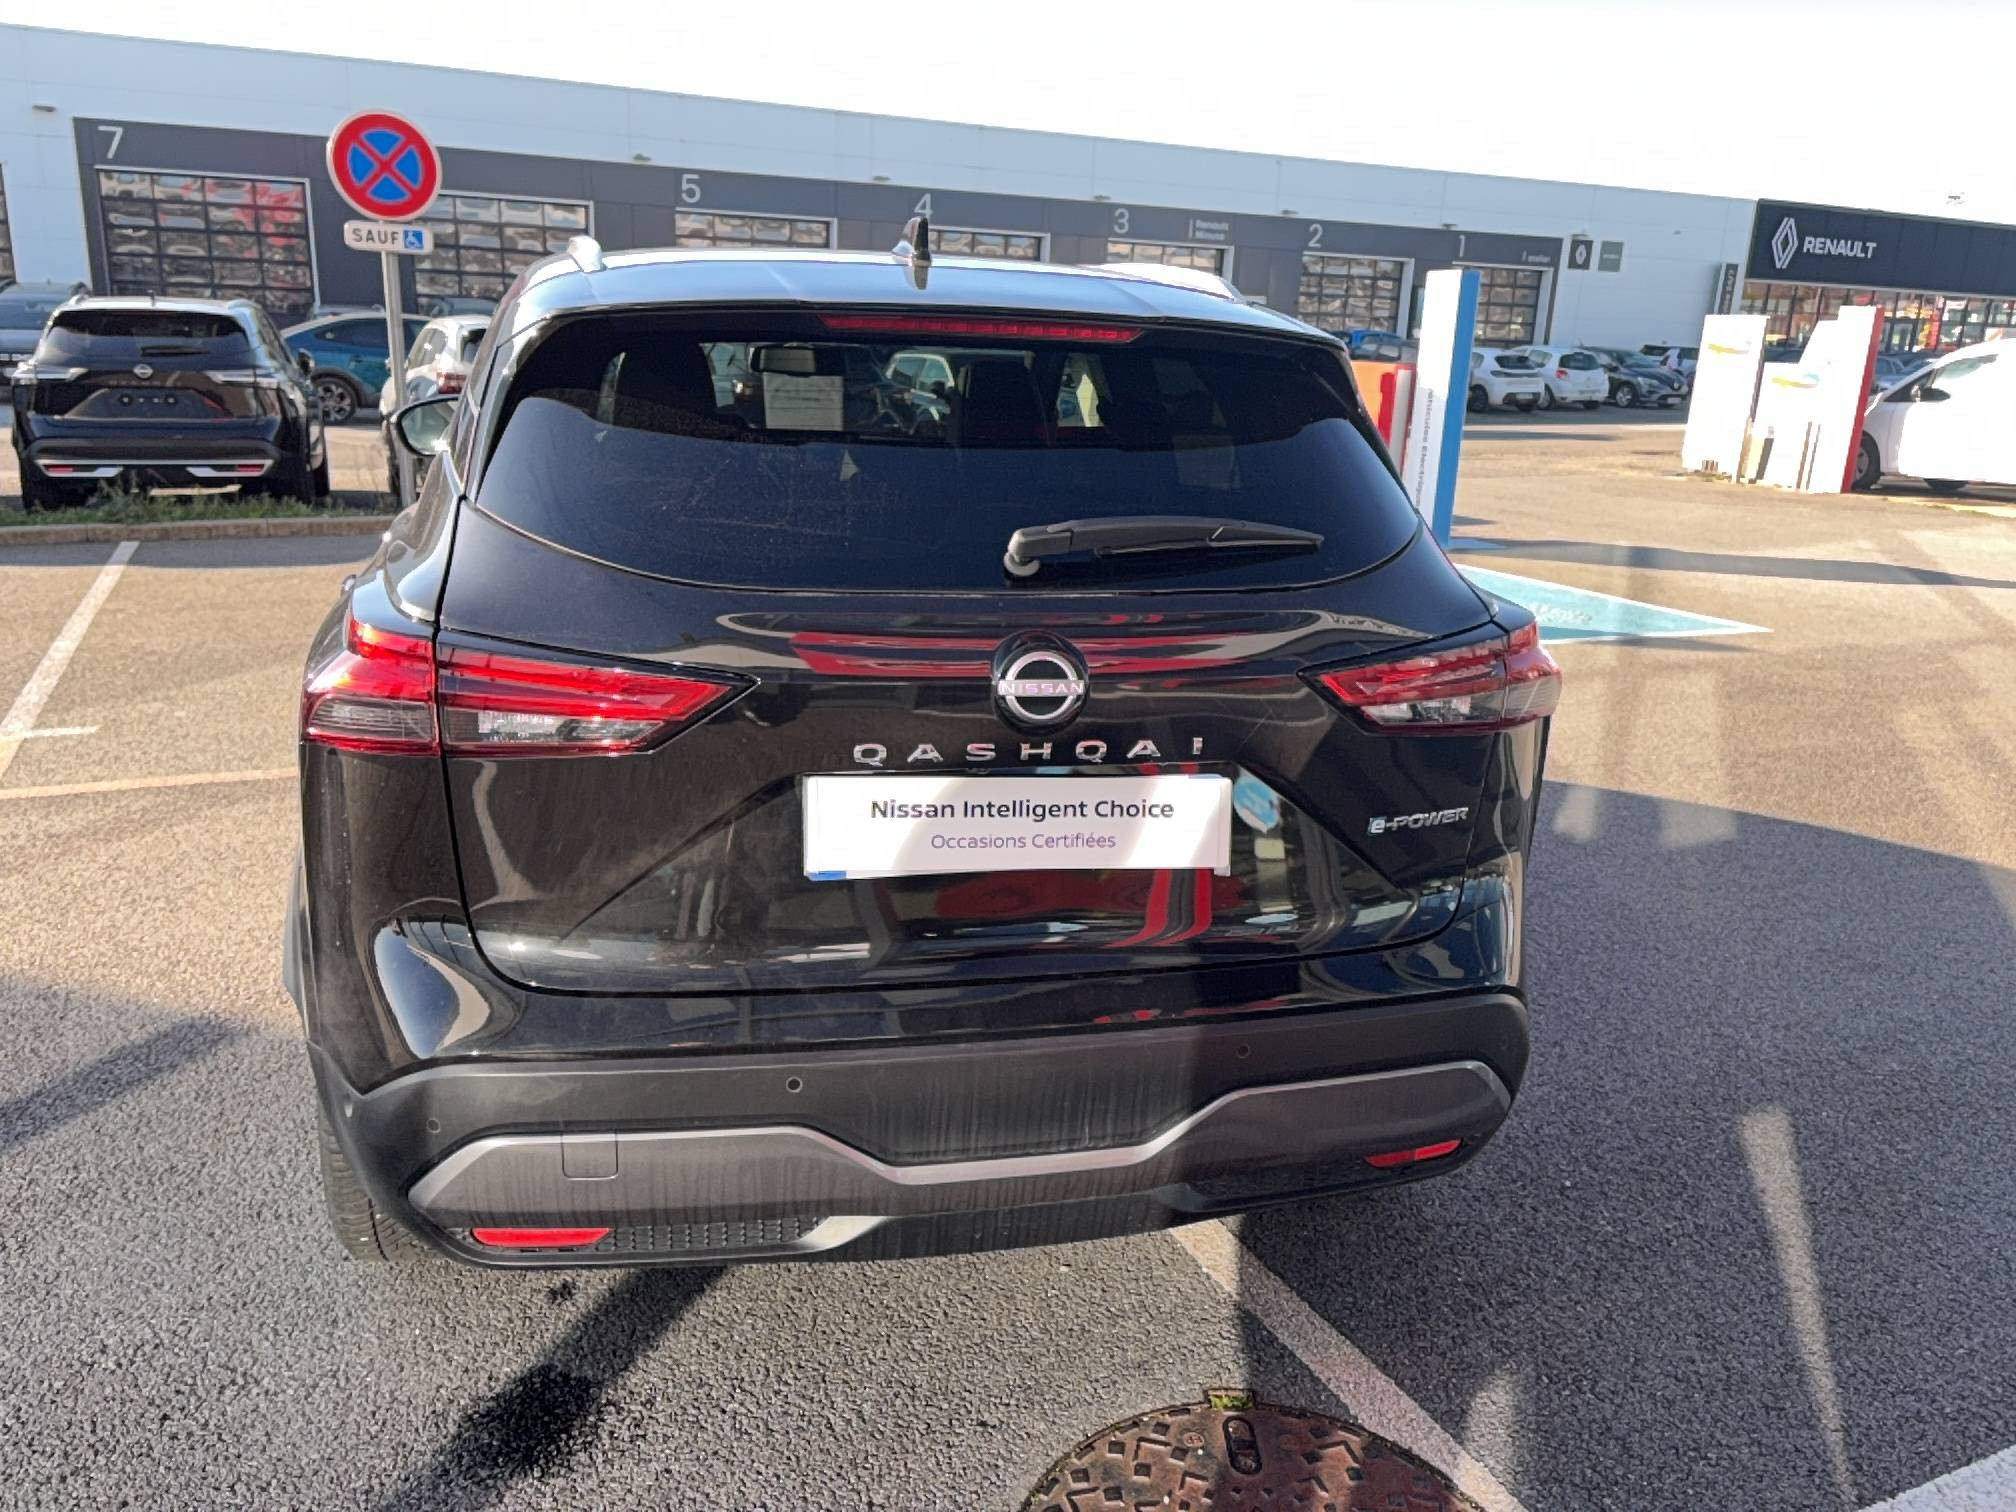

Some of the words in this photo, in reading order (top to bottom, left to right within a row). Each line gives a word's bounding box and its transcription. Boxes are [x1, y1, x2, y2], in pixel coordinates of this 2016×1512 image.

[97, 125, 123, 159] 7
[681, 173, 701, 203] 5
[913, 193, 933, 220] 4
[1112, 208, 1129, 234] 3
[352, 228, 399, 244] SAUF
[1308, 223, 1323, 247] 2
[1459, 235, 1465, 257] 1
[1803, 236, 1877, 259] RENAULT
[1001, 682, 1084, 694] NISSAN
[853, 737, 1204, 767] QASHQAI
[871, 800, 955, 819] Nissan
[963, 799, 1088, 823] Intelligent
[1094, 799, 1175, 819] Choice
[1368, 807, 1469, 834] e-POWER
[931, 833, 1026, 850] Occasions
[1031, 832, 1117, 850] Certifiées
